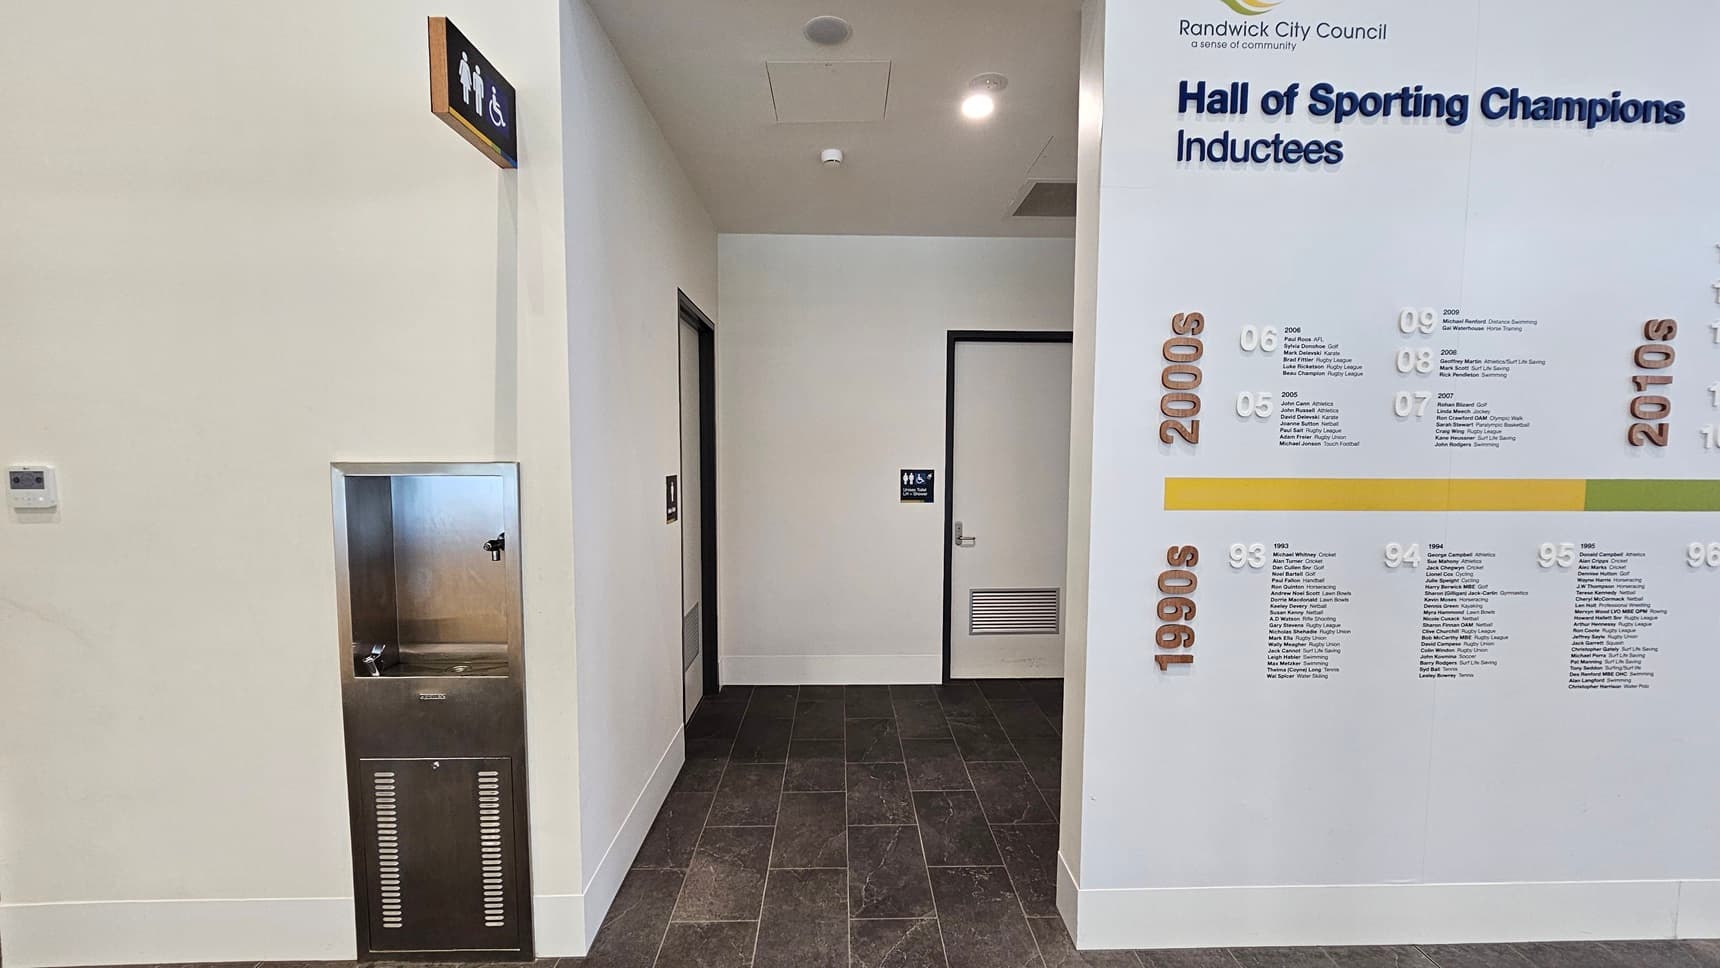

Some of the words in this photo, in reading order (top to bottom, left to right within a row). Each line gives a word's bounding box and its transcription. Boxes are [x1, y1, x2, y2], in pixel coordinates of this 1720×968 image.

[1179, 19, 1269, 38] Randwick
[1275, 21, 1311, 42] City
[1316, 23, 1387, 41] Council
[1191, 40, 1198, 48] a
[1202, 40, 1227, 49] sense
[1230, 39, 1240, 49] of
[1242, 40, 1297, 52] community
[1178, 80, 1249, 116] Hall
[1260, 81, 1298, 116] of
[1308, 82, 1468, 126] Sporting
[1480, 87, 1686, 129] Champions
[1177, 130, 1344, 165] Inductees
[1399, 306, 1436, 334] 09
[1239, 324, 1277, 353] 06
[1397, 347, 1434, 374] 08
[1159, 311, 1204, 445] 2000s
[1627, 318, 1677, 447] 2010s
[1236, 390, 1273, 419] 05
[1394, 391, 1432, 417] 07
[1229, 542, 1265, 570] 93
[1384, 542, 1421, 569] 94
[1537, 542, 1576, 569] 95
[1687, 541, 1720, 568] 96
[1154, 544, 1199, 671] 1990s
